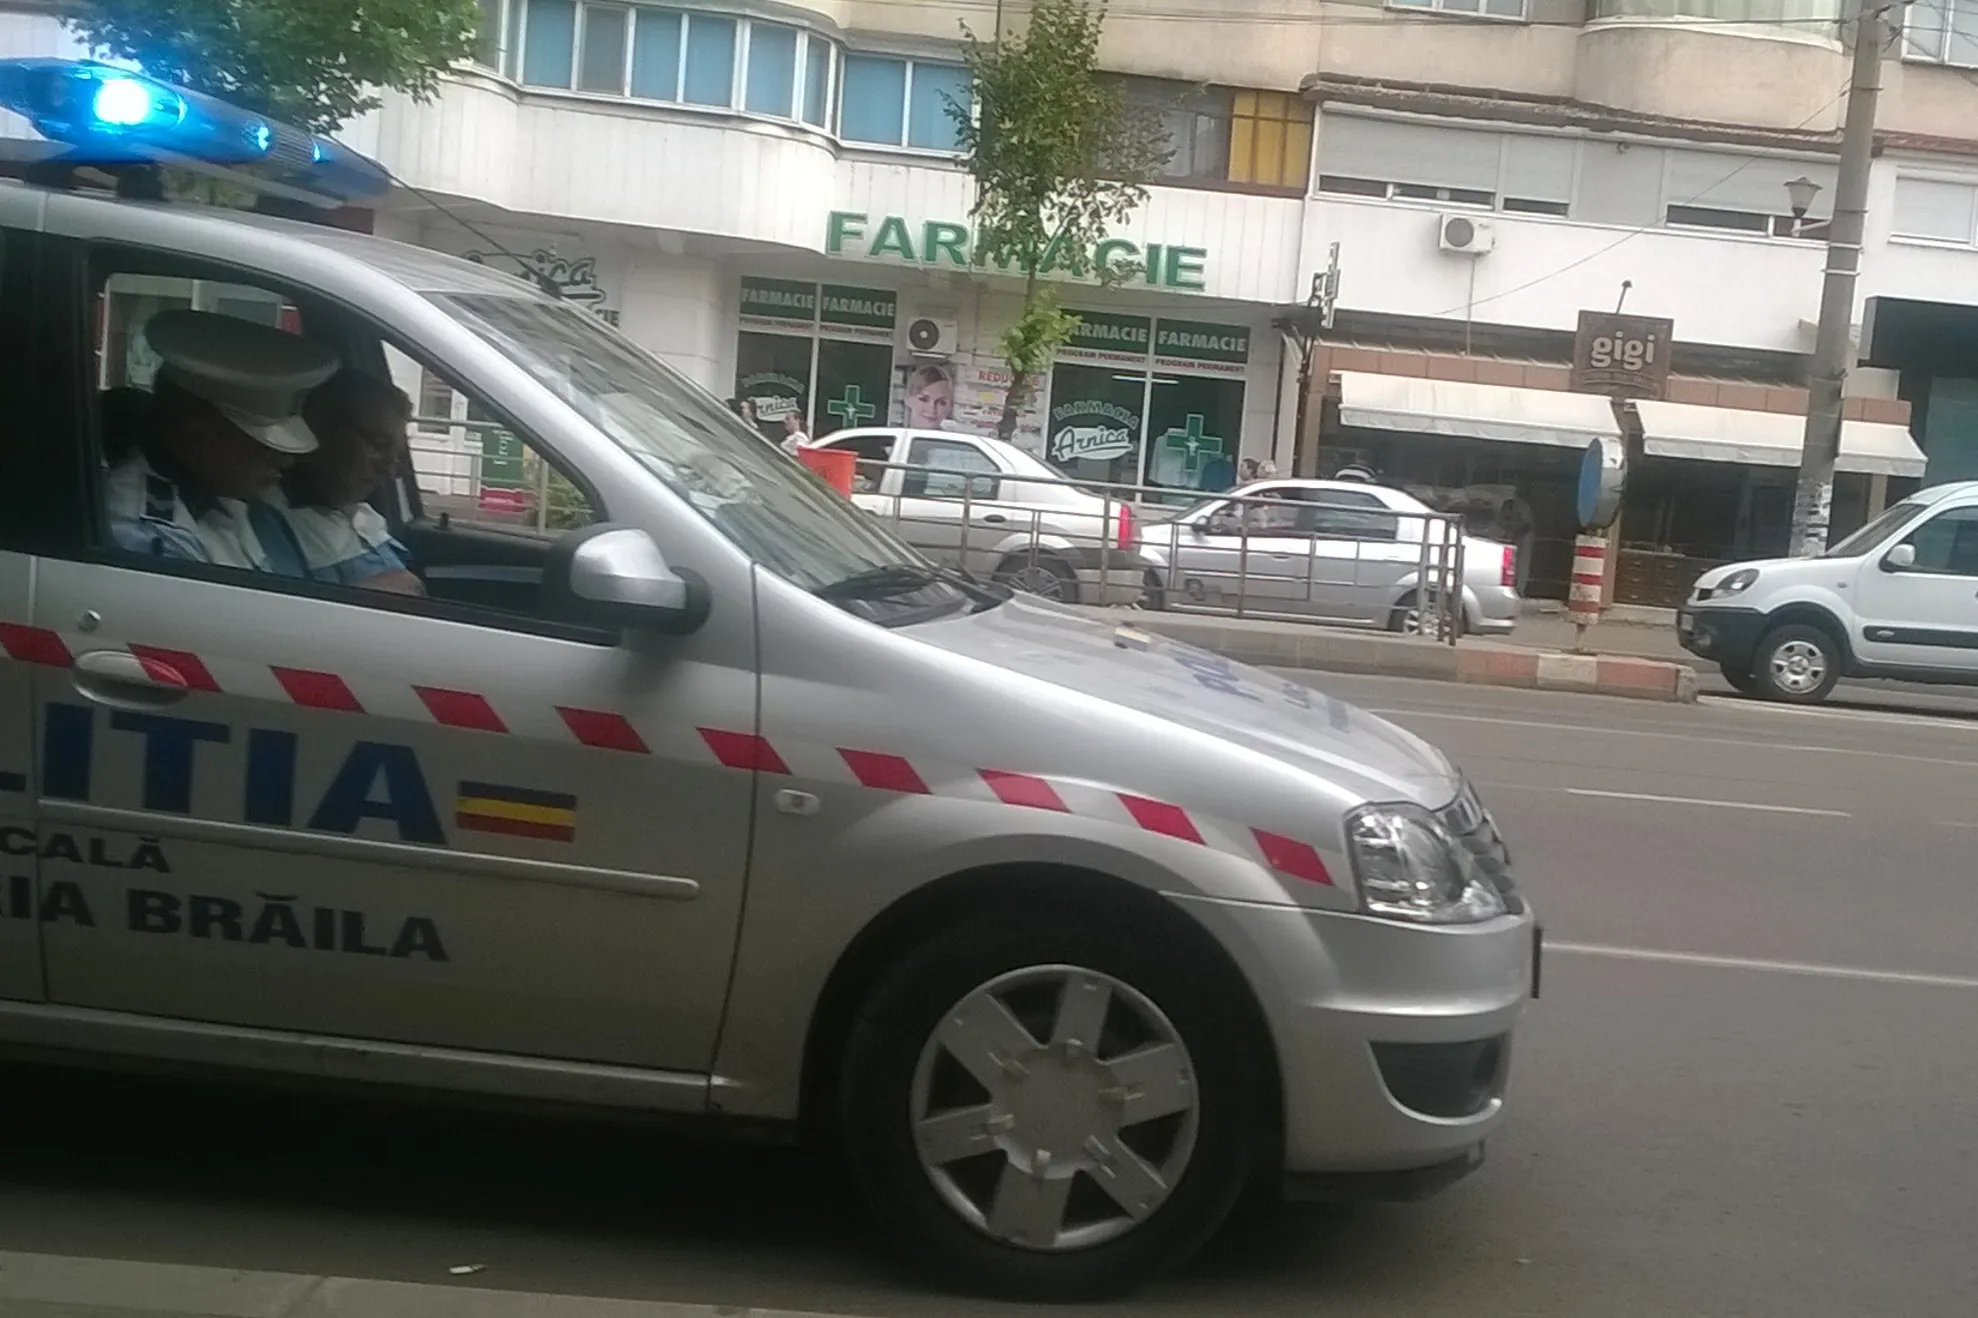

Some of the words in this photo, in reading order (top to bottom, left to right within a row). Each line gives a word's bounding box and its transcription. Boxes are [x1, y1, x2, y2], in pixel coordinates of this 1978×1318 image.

[741, 288, 815, 309] FARMACIE
[823, 296, 896, 317] FARMACIE
[1066, 322, 1149, 343] ARMACIE
[1158, 330, 1248, 352] FARMACIE
[1590, 330, 1655, 371] gigi
[1053, 427, 1130, 460] Arnica
[0, 702, 448, 845] ITIA
[126, 887, 449, 961] BRĂILA
